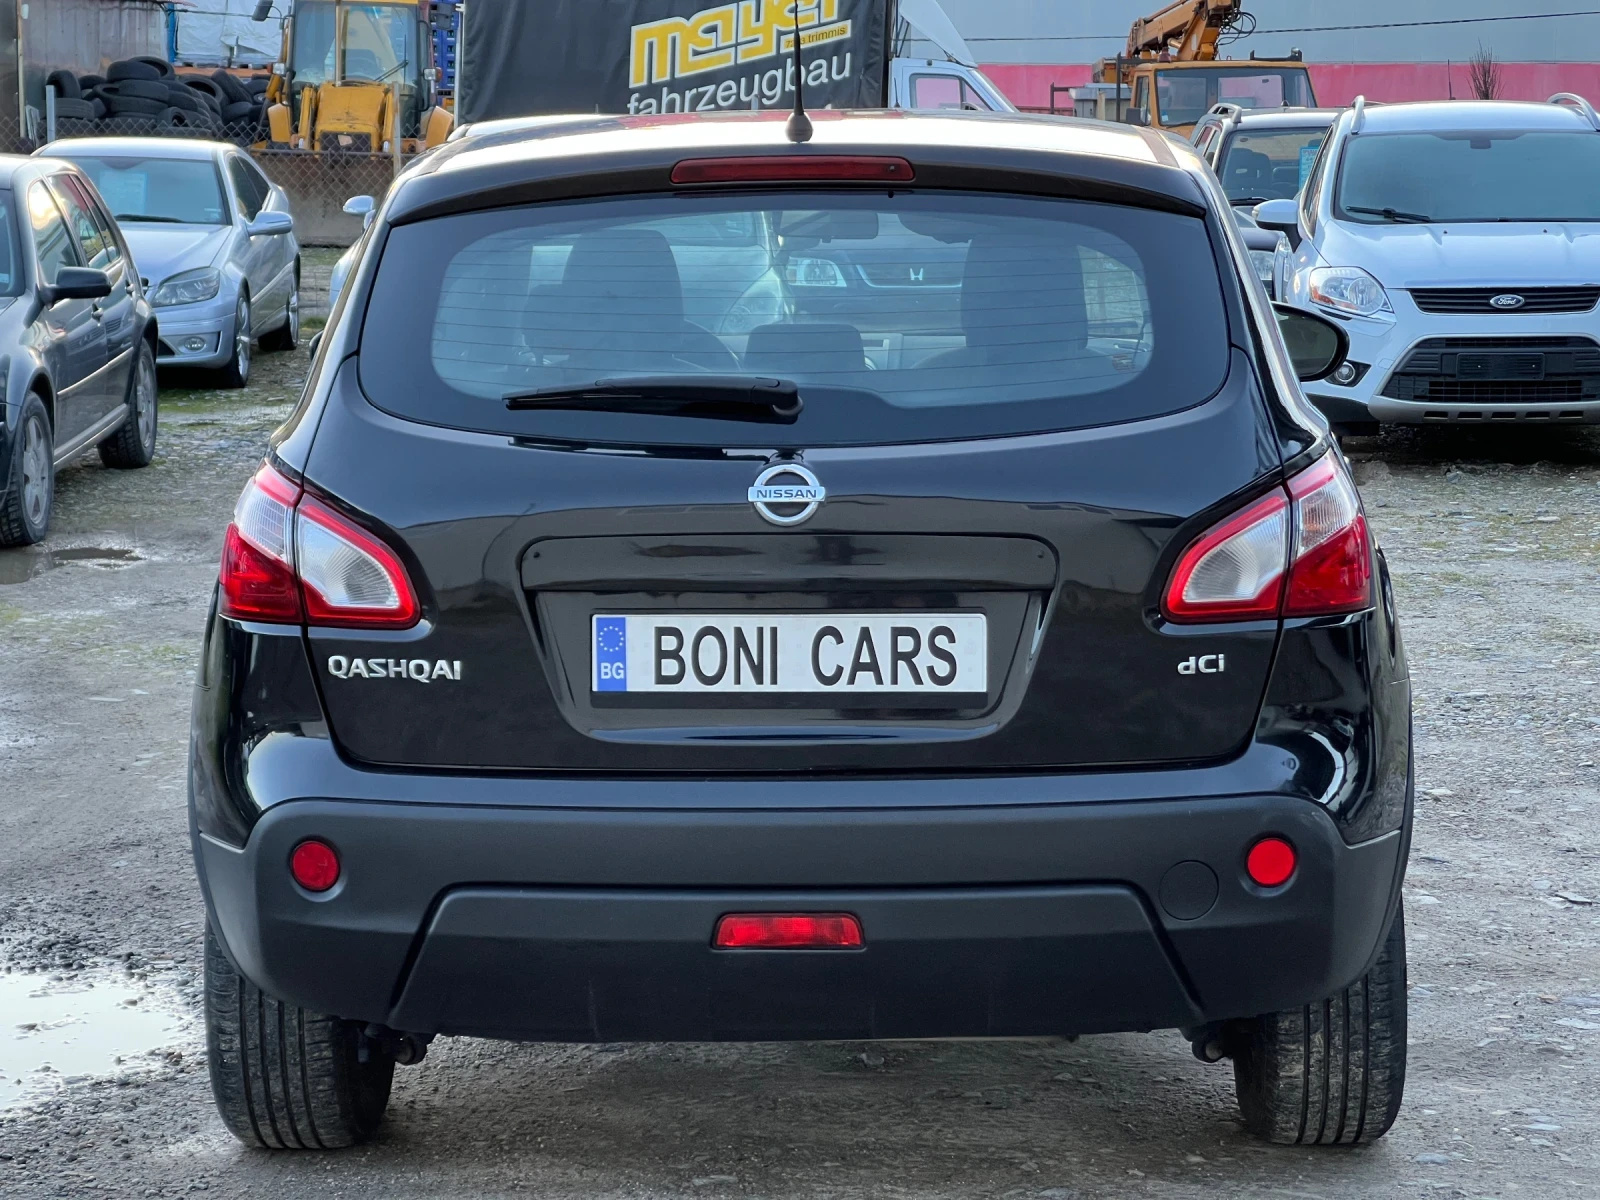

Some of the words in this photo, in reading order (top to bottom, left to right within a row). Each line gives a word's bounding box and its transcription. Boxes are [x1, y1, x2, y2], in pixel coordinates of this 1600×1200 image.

[785, 37, 806, 48] 723
[808, 26, 846, 43] trimmis
[626, 52, 851, 115] fahrzeugbau
[756, 489, 817, 499] NISSAN
[653, 625, 779, 687] BONI
[810, 625, 958, 687] CARS
[1177, 653, 1225, 675] dCi
[327, 655, 462, 684] QASHQAI
[600, 661, 626, 681] BG
